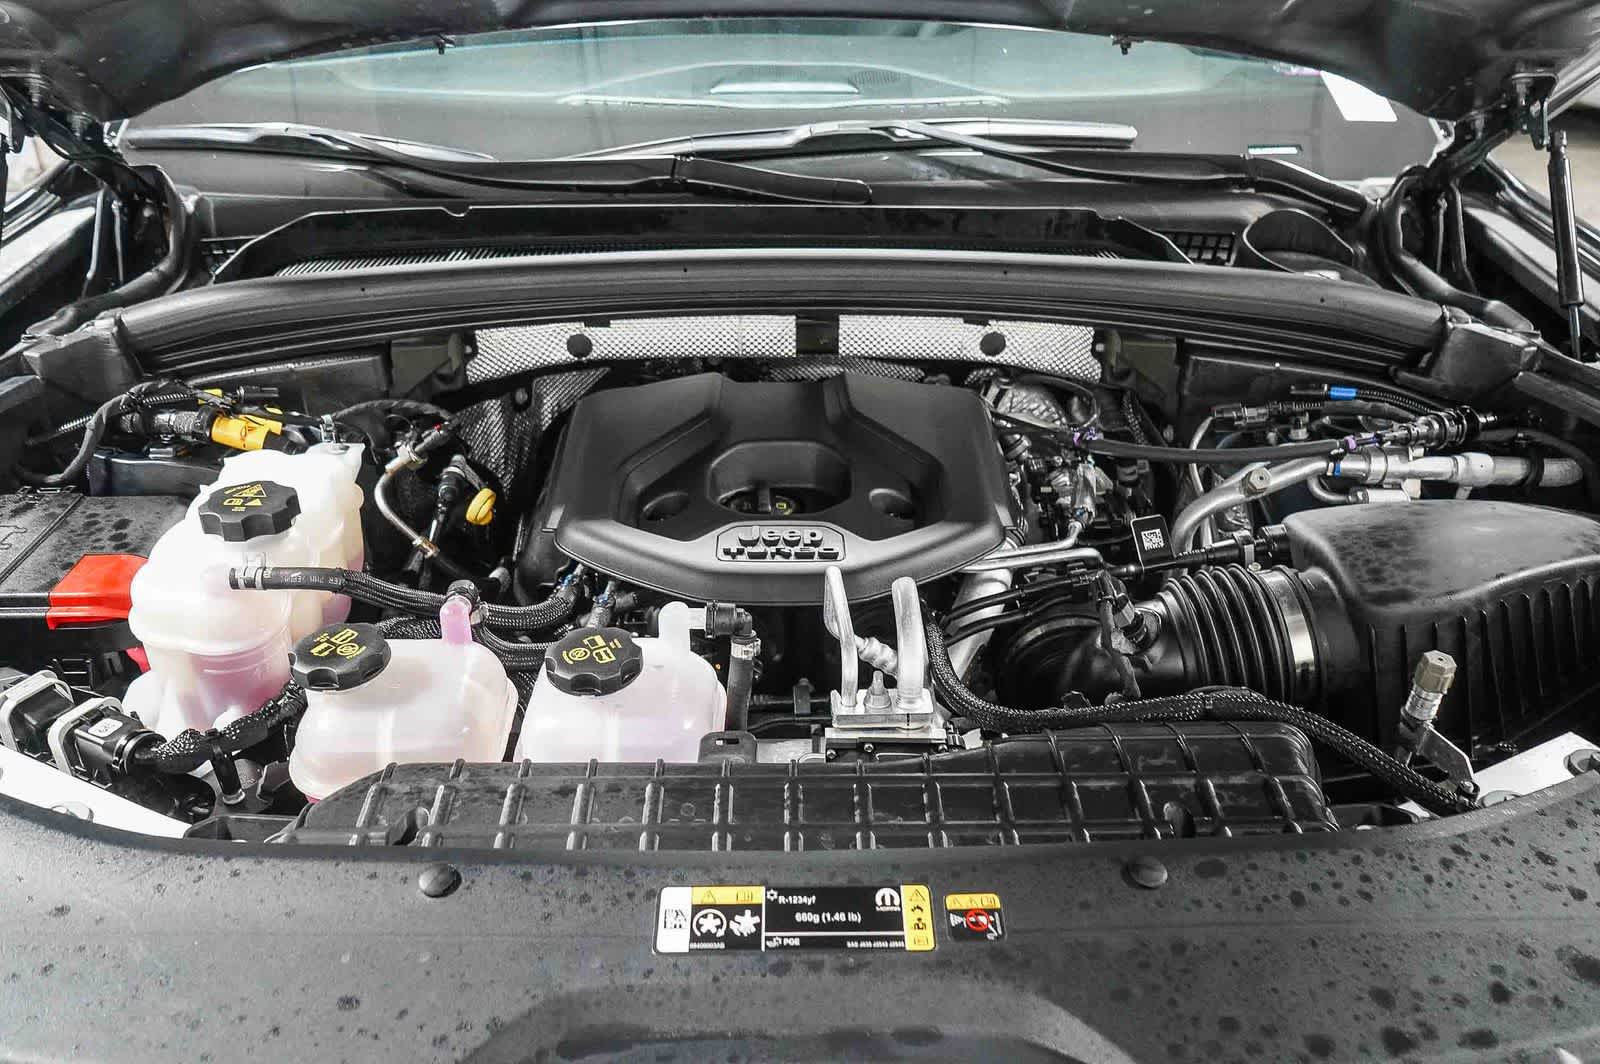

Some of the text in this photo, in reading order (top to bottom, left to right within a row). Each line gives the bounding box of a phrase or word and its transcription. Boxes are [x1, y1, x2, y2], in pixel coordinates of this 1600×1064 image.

[738, 525, 824, 549] Jeep
[778, 895, 817, 906] R-1234yf
[847, 911, 862, 924] lb)
